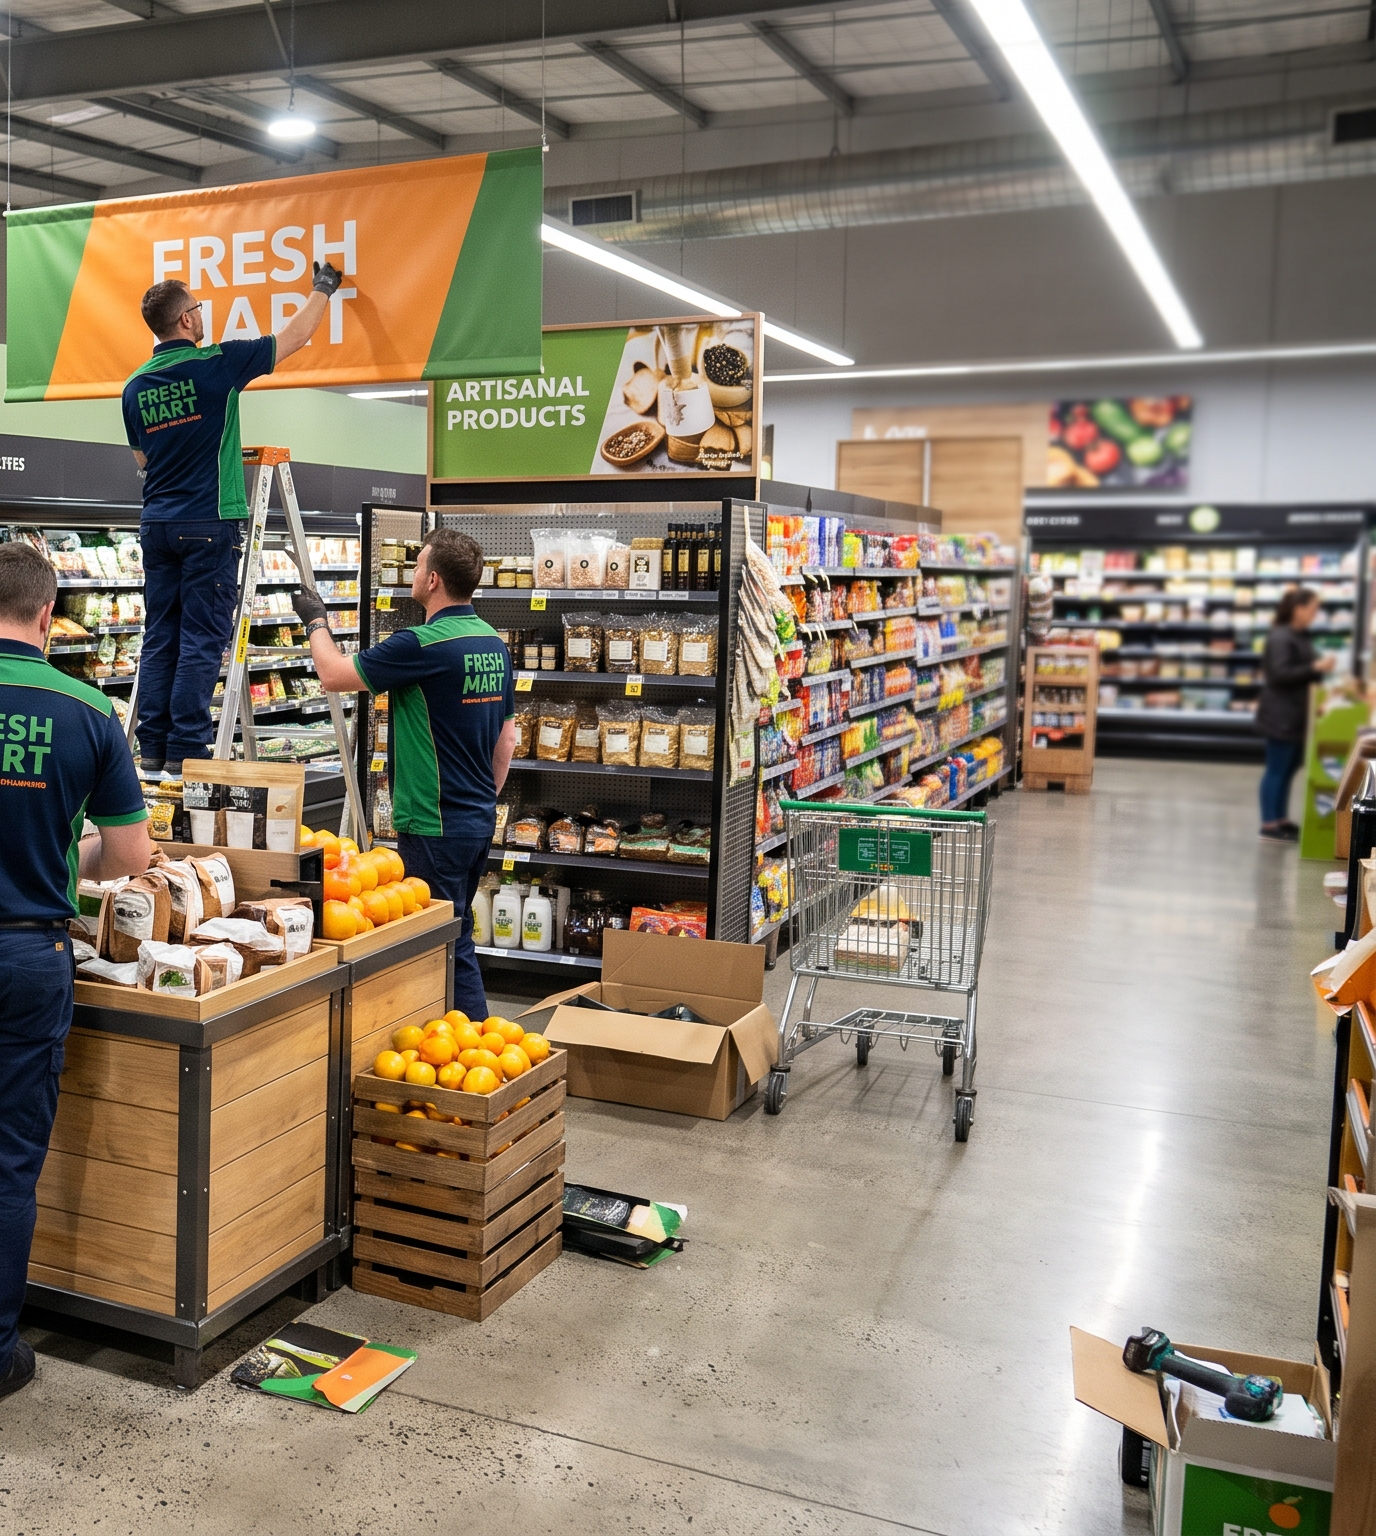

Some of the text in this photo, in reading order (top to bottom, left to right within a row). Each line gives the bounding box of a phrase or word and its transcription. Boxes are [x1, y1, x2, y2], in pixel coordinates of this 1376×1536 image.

[153, 219, 358, 291] FRESH
[137, 379, 196, 409] FRESH
[446, 375, 590, 403] ARTISANAL
[140, 395, 198, 427] MART
[447, 404, 586, 431] PRODUCTS
[464, 652, 505, 673] FRESH
[462, 672, 505, 695] MART
